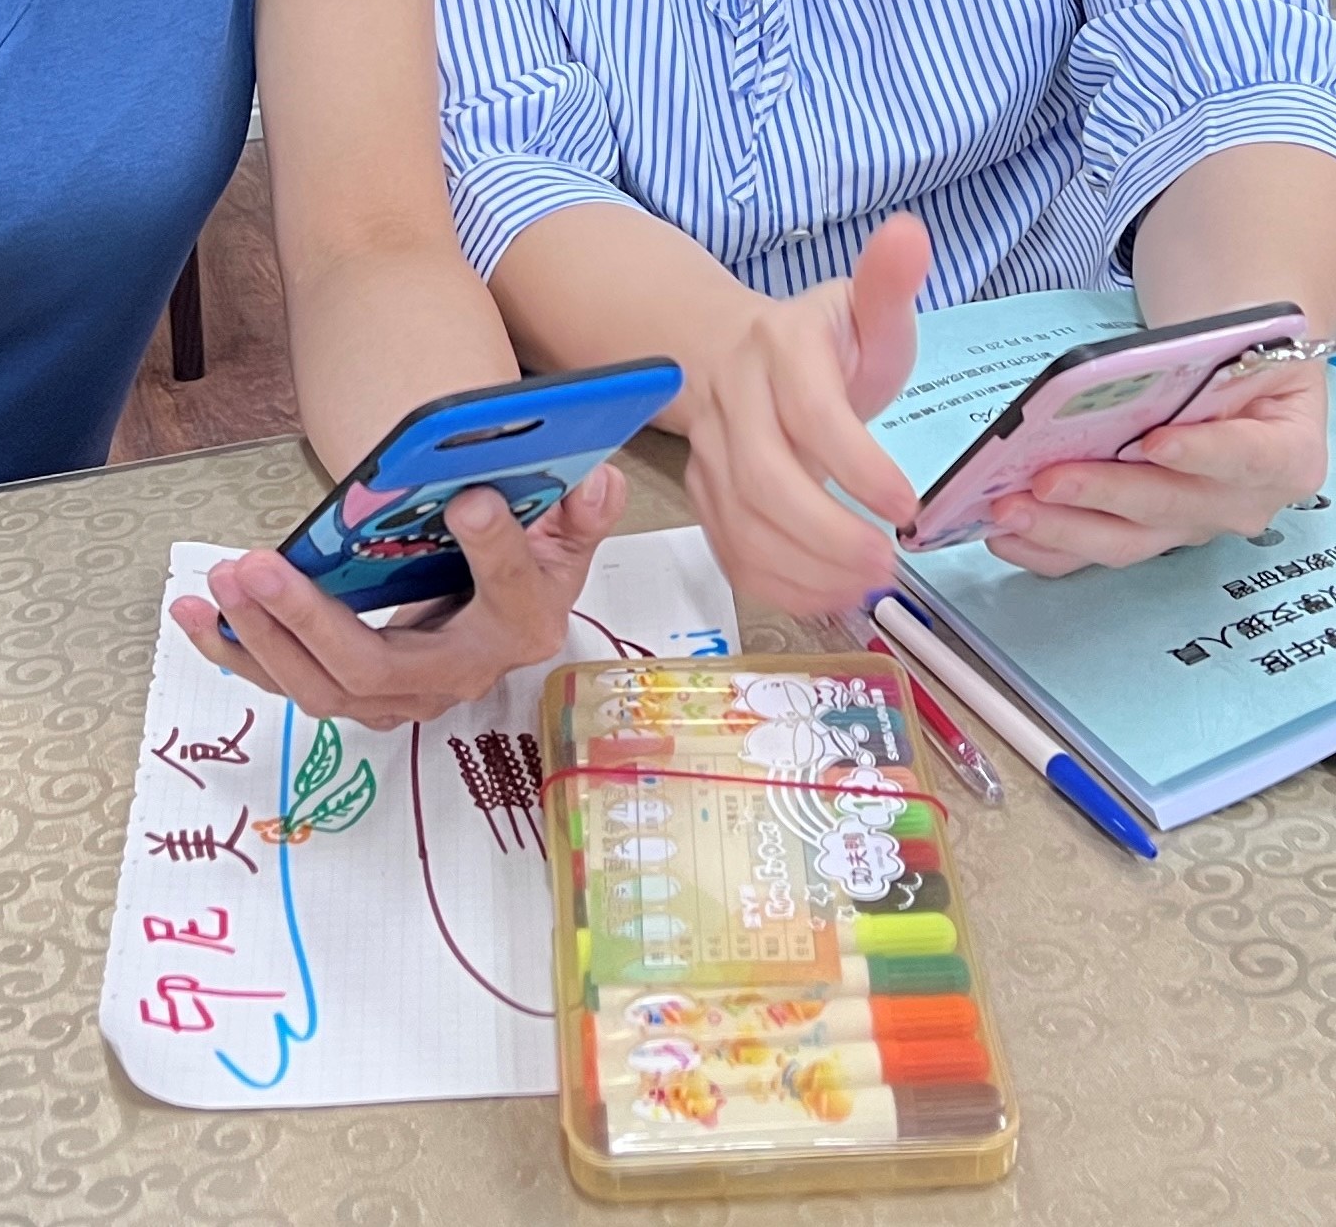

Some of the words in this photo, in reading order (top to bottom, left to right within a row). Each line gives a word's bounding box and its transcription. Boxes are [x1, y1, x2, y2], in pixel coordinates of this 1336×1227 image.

[139, 707, 287, 1033] 印尼美食
[842, 832, 873, 887] 功夫鴨
